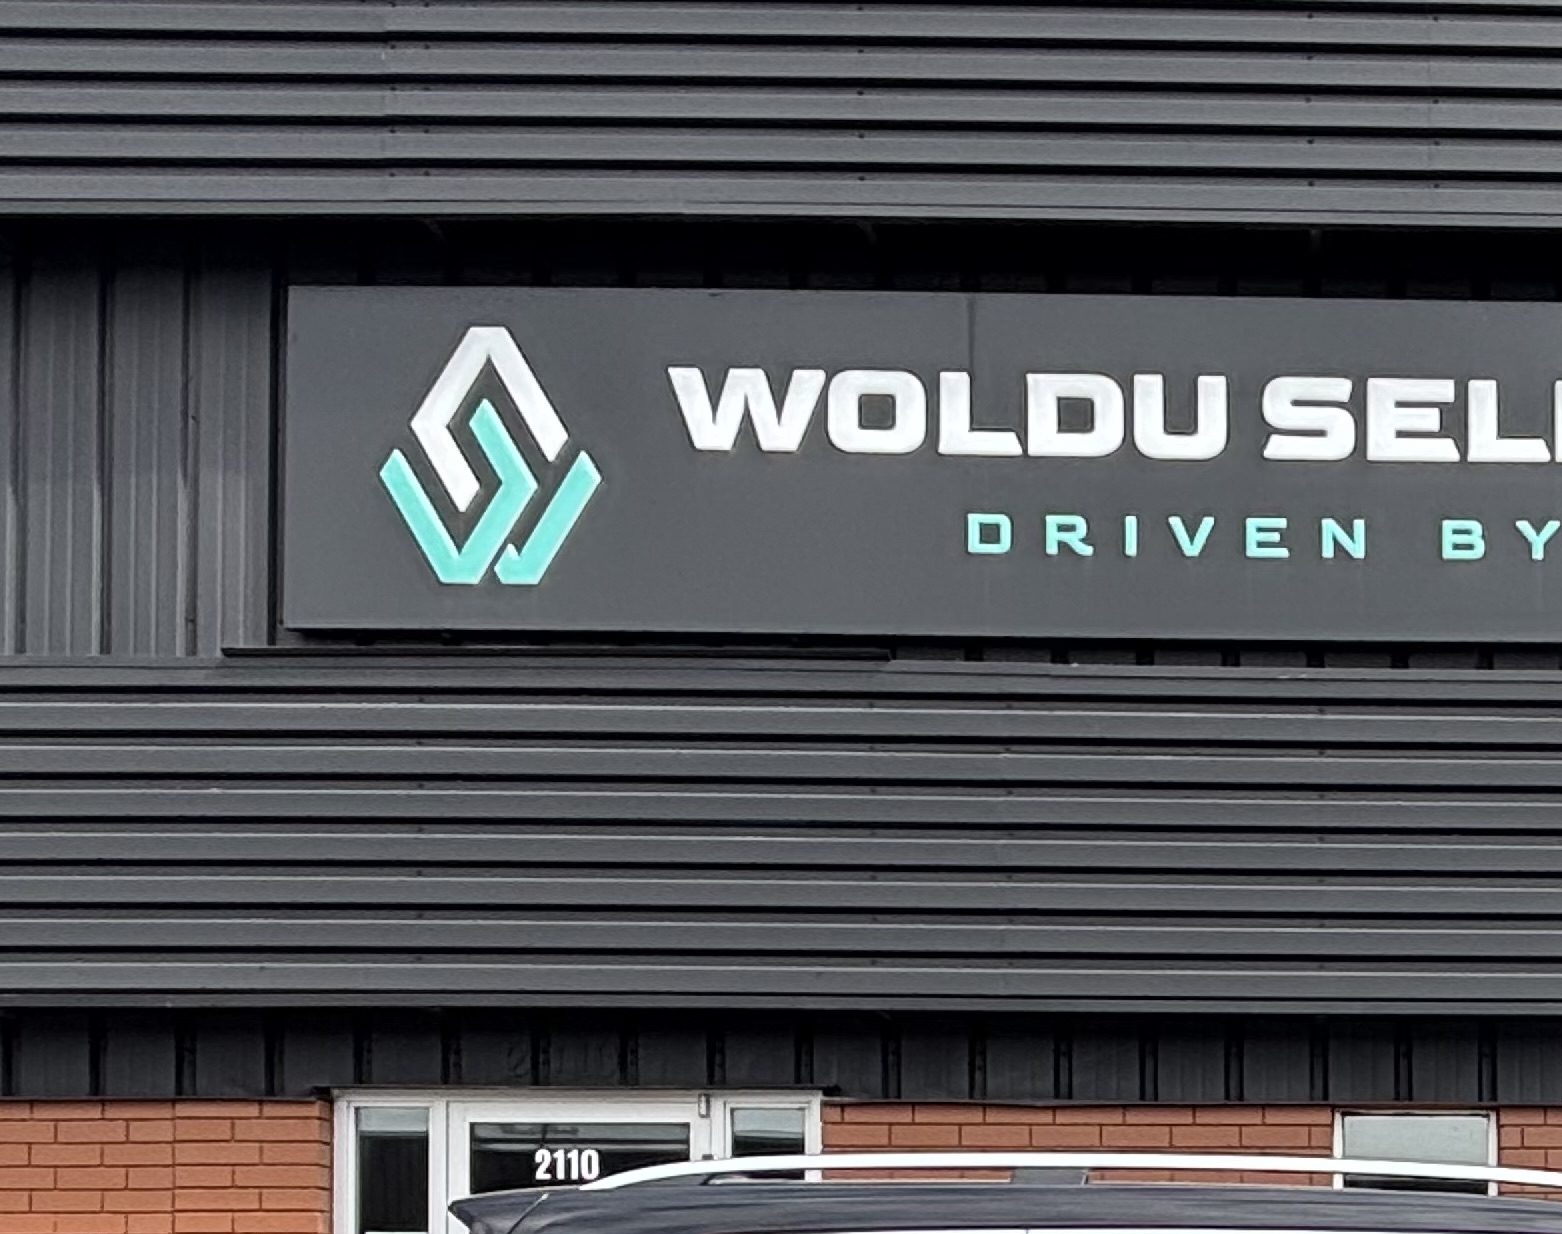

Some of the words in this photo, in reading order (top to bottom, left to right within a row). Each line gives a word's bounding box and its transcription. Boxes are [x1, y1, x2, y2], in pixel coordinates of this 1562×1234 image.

[666, 366, 1229, 460] WOLDU
[966, 513, 1367, 559] DRIVEN
[1441, 519, 1561, 561] BY
[534, 1148, 600, 1181] 2110
